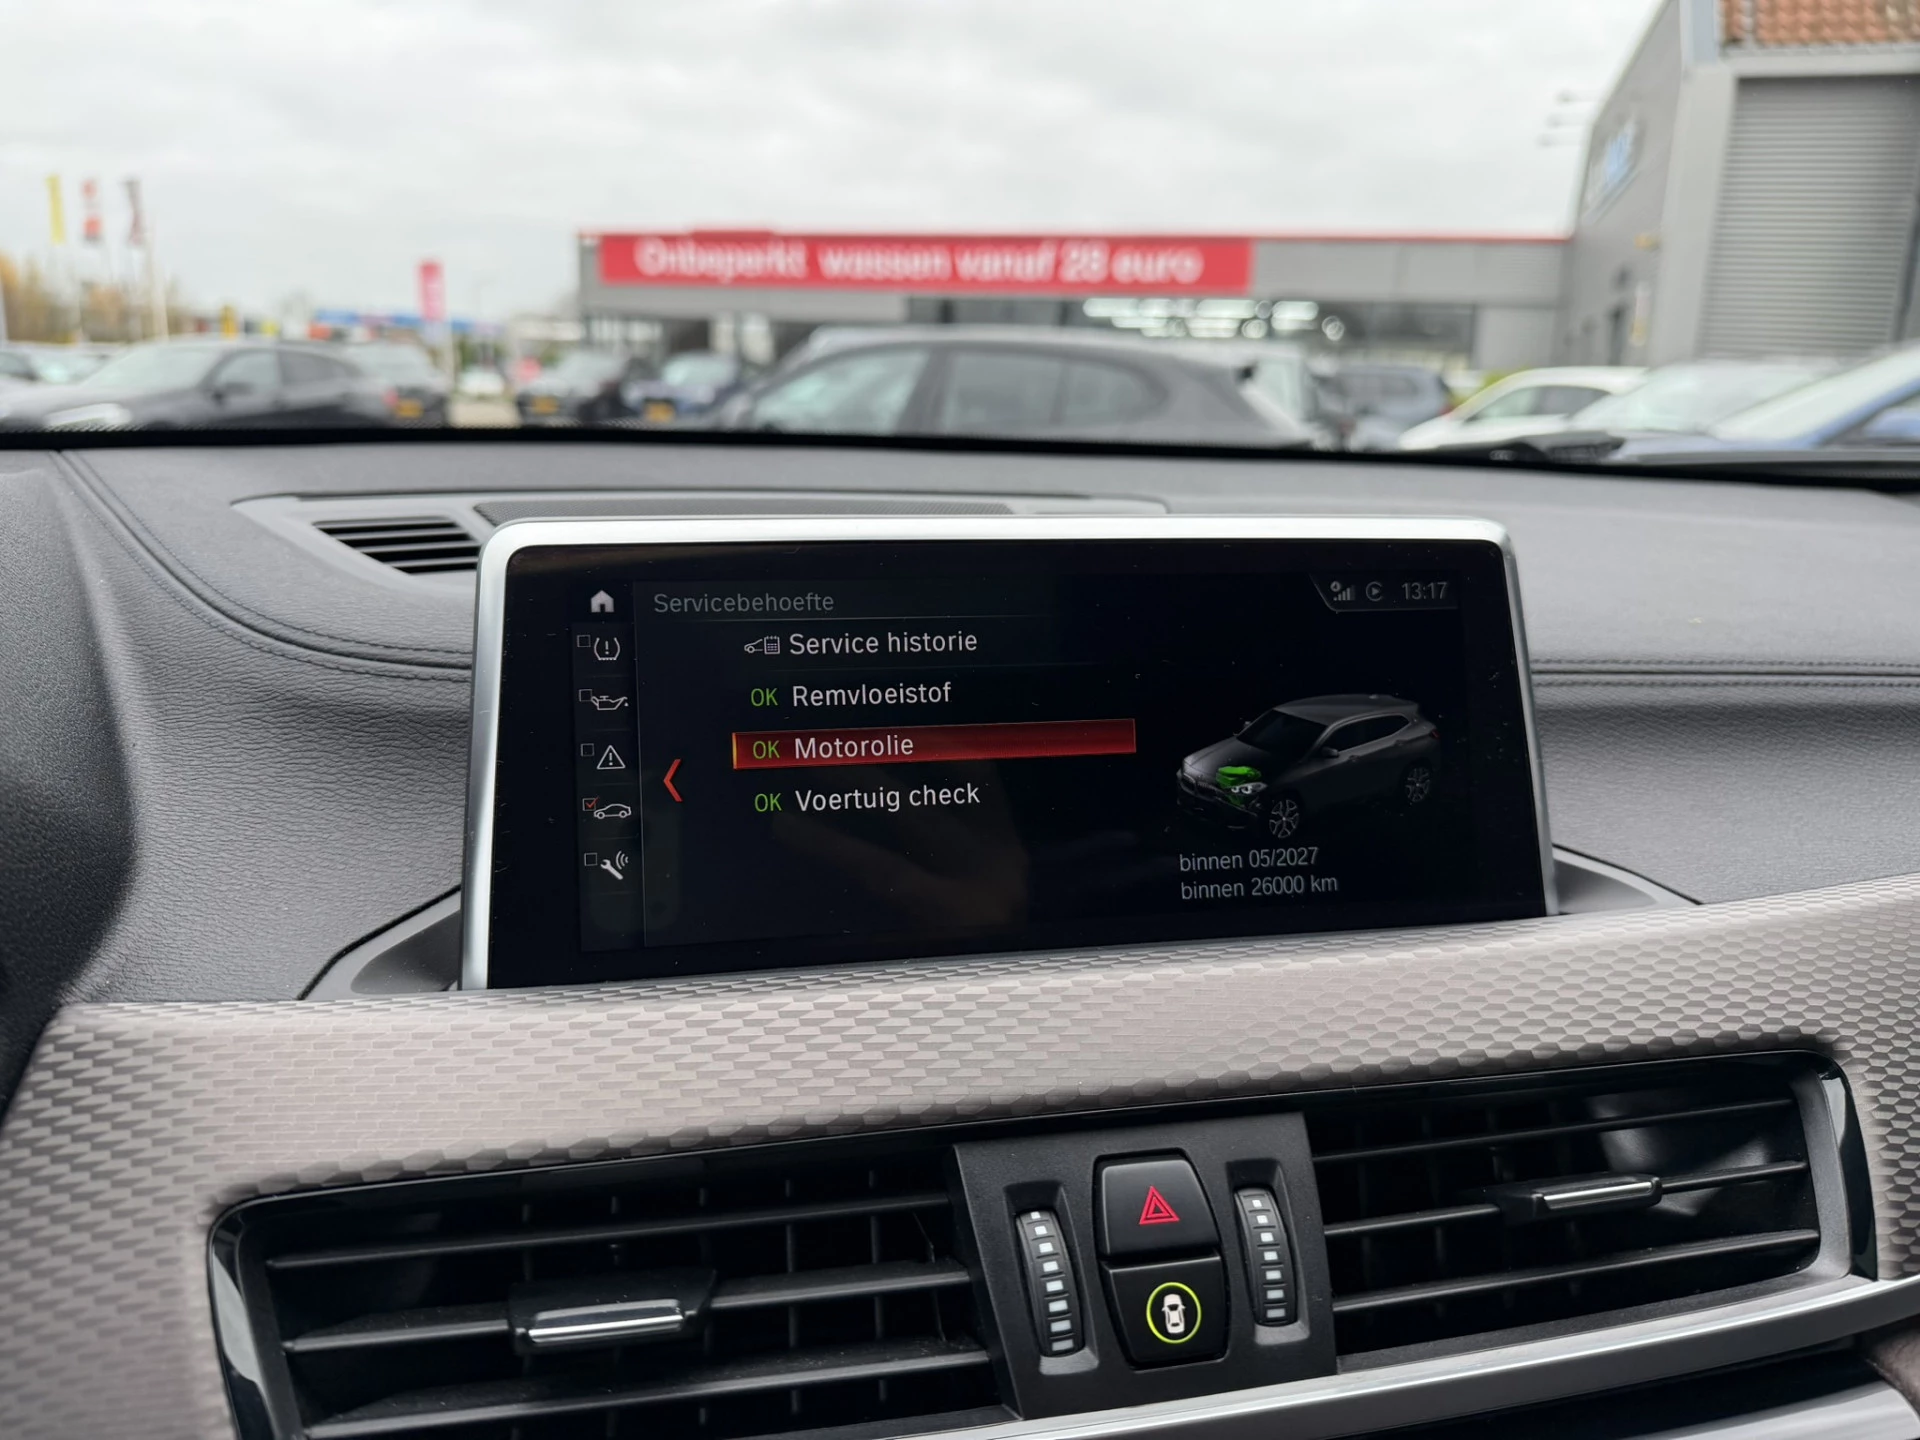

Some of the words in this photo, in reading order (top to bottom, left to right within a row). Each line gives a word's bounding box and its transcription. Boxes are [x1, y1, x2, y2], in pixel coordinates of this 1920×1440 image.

[818, 247, 949, 280] wassen
[954, 240, 1054, 281] vanaf
[1111, 247, 1203, 282] euro
[653, 592, 835, 614] Servicebehoefte
[1401, 581, 1448, 600] 13:17
[788, 633, 880, 656] Service
[887, 630, 978, 653] historie
[750, 687, 779, 707] OK
[792, 681, 952, 708] Remvloeistof
[752, 740, 781, 760] OK
[794, 735, 914, 760] Motorolie
[754, 792, 782, 813] OK
[795, 785, 901, 814] Voertuig
[908, 782, 981, 807] check
[1179, 851, 1243, 872] binnen
[1249, 846, 1319, 869] 05/2027
[1181, 879, 1245, 900] binnen
[1251, 874, 1305, 896] 26000
[1310, 874, 1338, 894] km
